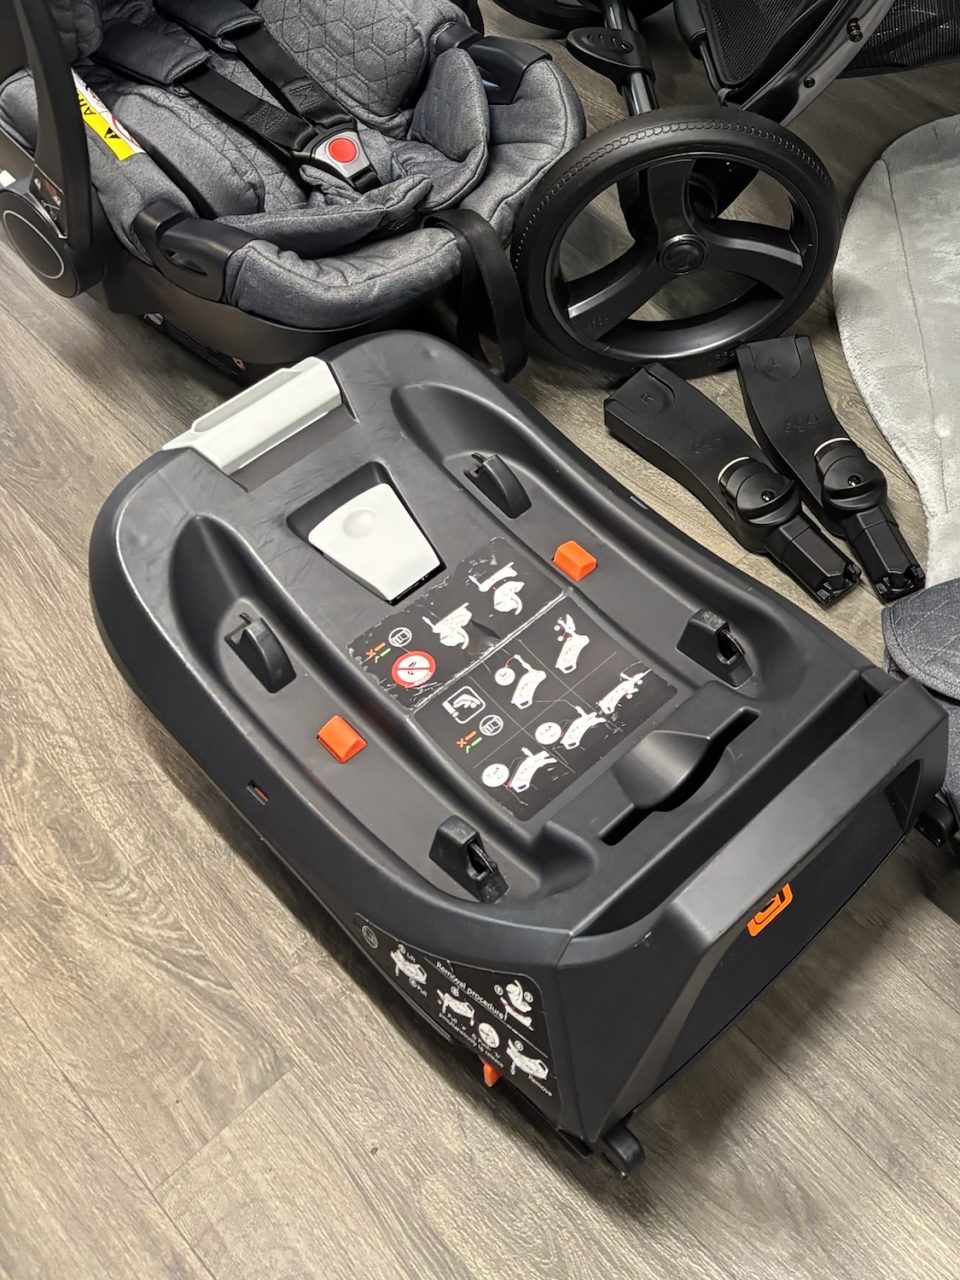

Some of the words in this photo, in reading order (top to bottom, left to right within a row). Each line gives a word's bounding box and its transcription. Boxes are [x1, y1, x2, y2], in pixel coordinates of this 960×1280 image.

[436, 961, 467, 990] Removal
[466, 987, 504, 1020] procedure
[528, 1074, 553, 1097] Remove
